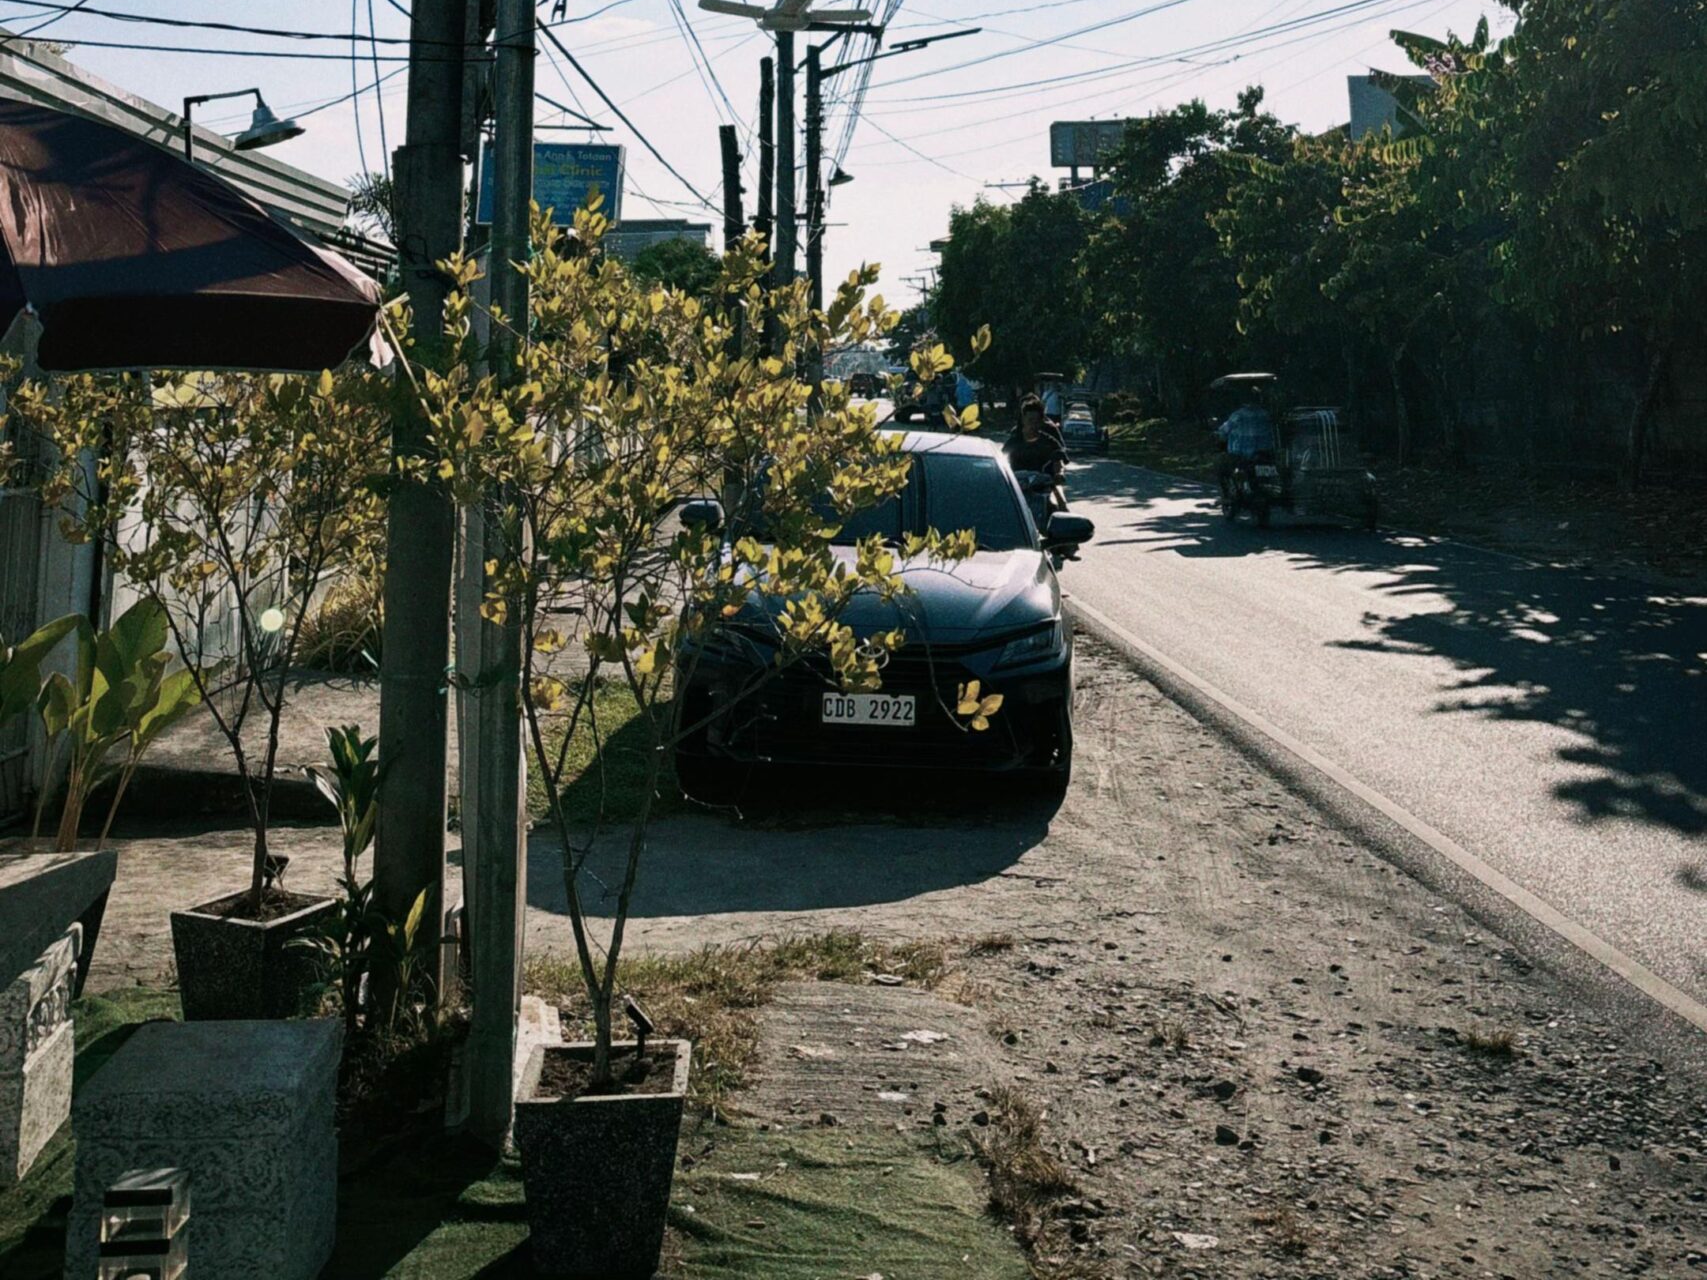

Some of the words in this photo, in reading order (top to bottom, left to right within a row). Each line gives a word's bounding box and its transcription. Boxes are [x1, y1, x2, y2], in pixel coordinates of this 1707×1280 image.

[559, 164, 603, 177] Clinic
[823, 697, 856, 718] CDB
[869, 700, 914, 720] 2922
